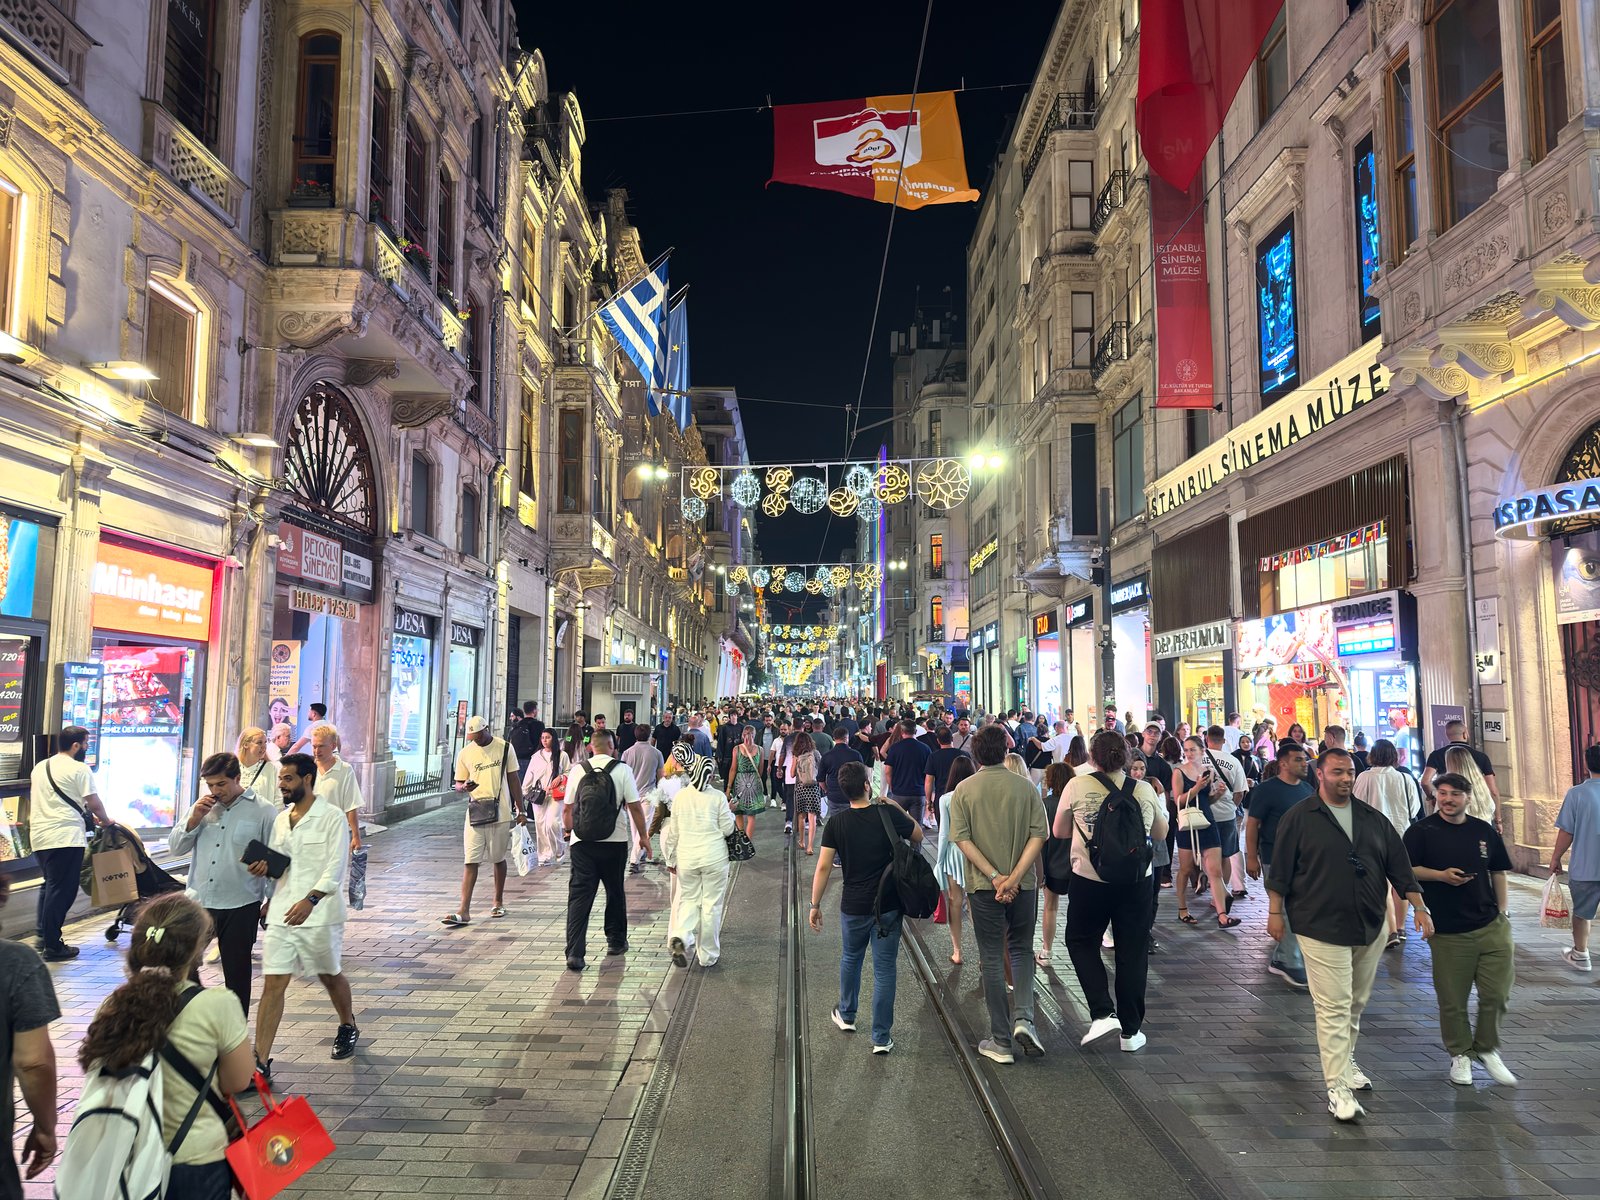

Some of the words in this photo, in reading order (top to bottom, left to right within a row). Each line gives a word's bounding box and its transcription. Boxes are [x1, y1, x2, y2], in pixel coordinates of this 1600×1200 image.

[1161, 254, 1201, 265] SİNEMA
[1222, 414, 1300, 477] SİNEMA
[304, 536, 339, 563] BEYOĞLU
[303, 555, 339, 581] SİNEMASI
[94, 562, 205, 611] Münhasır
[1332, 597, 1393, 623] CHANGE
[396, 613, 426, 635] DESA
[451, 623, 472, 645] DESA
